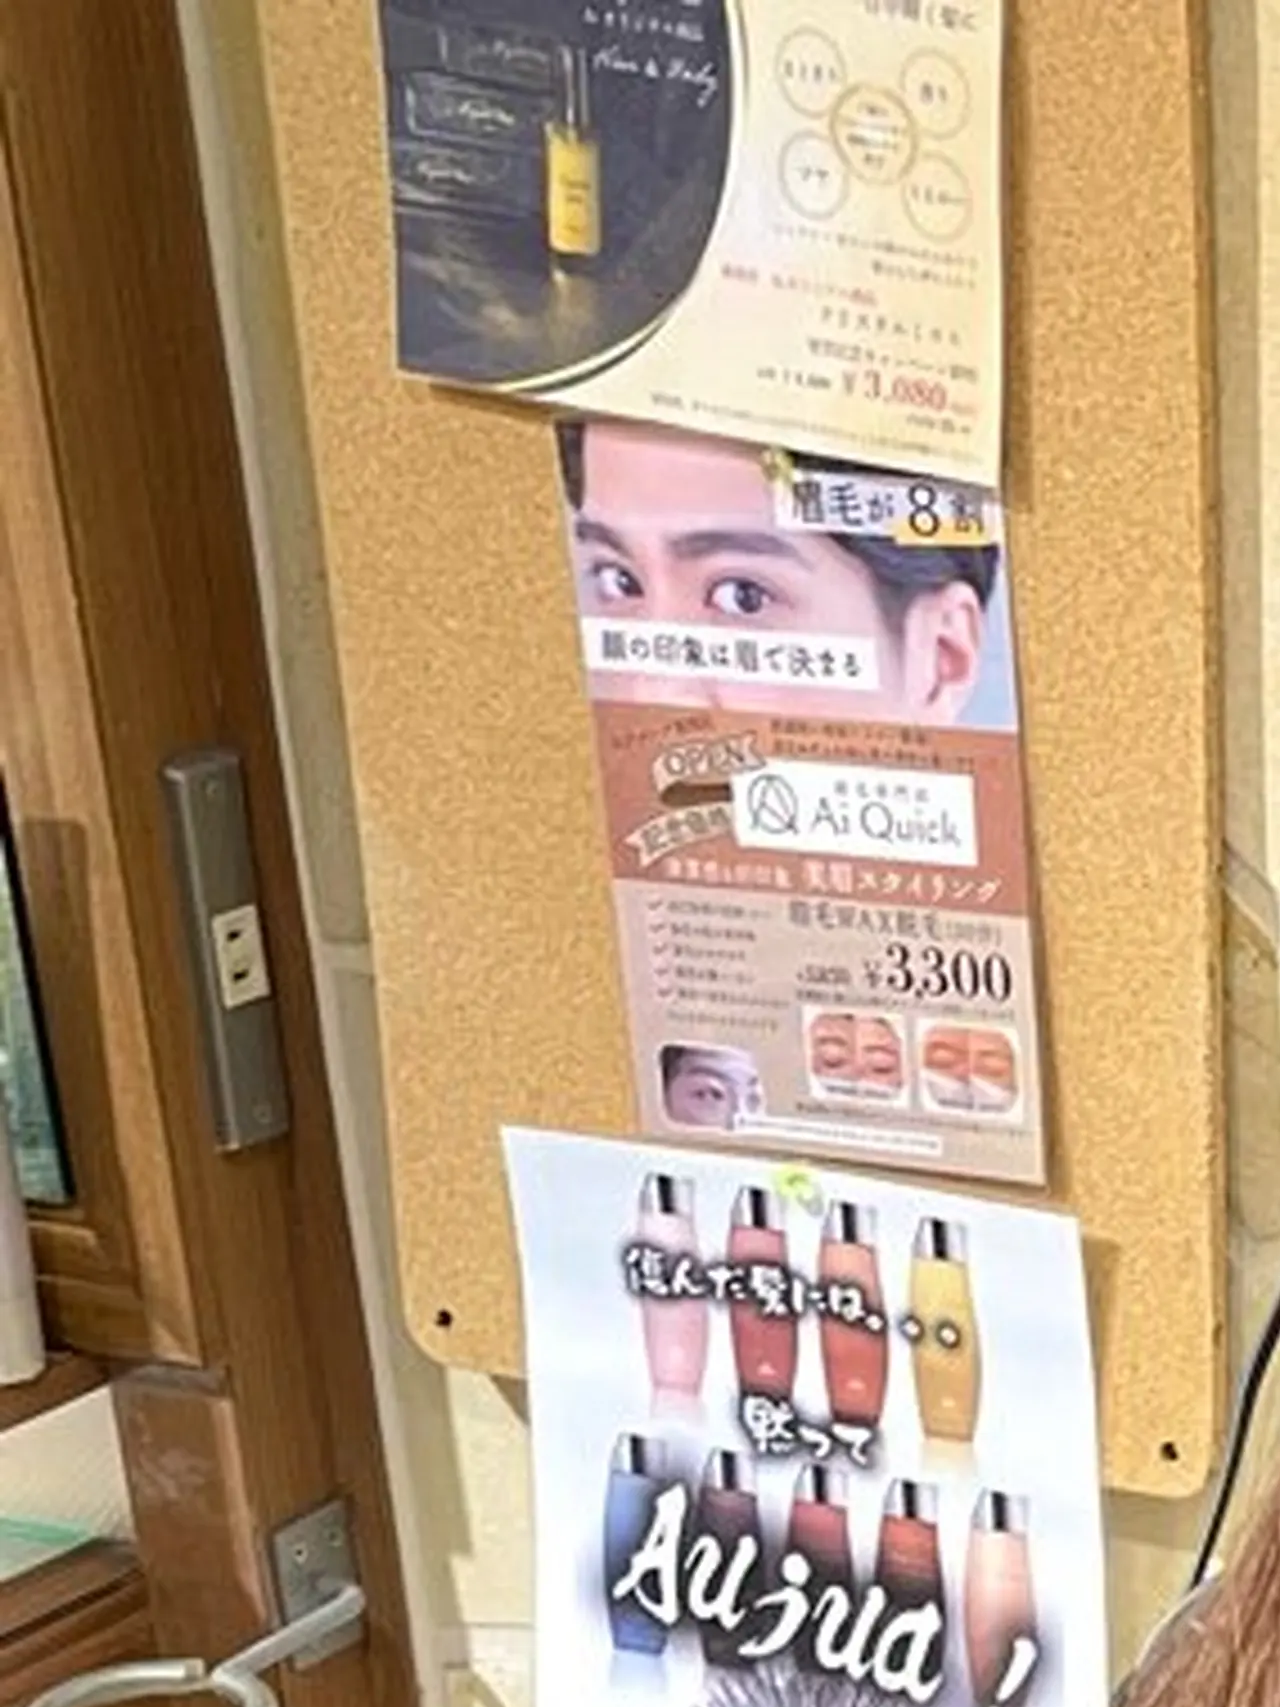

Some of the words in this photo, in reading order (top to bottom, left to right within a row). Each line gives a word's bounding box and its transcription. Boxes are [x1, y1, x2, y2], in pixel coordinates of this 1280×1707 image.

[600, 629, 862, 679] 顔の印象は眉で決まる
[859, 800, 961, 849] Quick
[863, 941, 1013, 1003] ¥3,300
